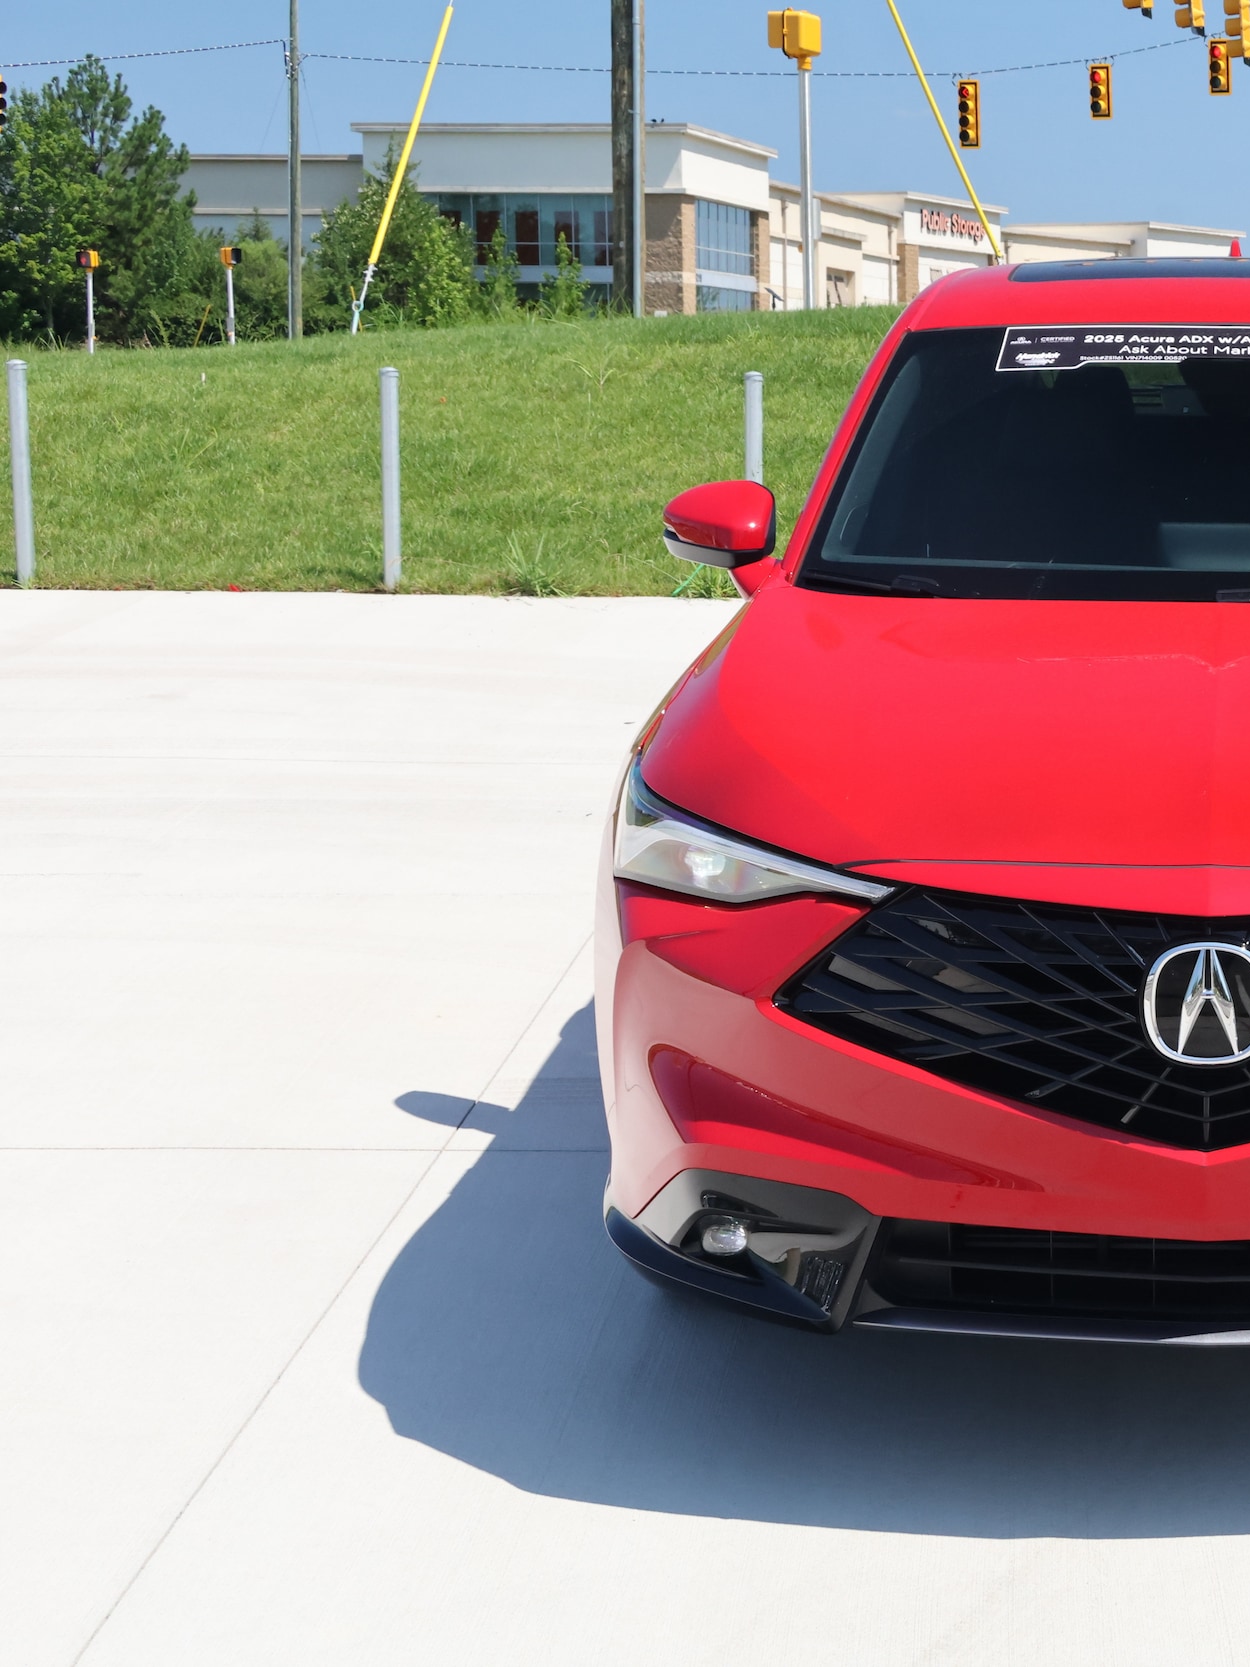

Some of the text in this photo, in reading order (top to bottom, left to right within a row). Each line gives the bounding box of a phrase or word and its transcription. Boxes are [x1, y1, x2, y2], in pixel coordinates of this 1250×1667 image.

[921, 209, 949, 233] Public
[1084, 335, 1125, 343] 2025
[1128, 334, 1175, 344] Acura
[1179, 335, 1214, 344] ADX
[1119, 345, 1150, 354] Ask
[1153, 345, 1208, 354] About
